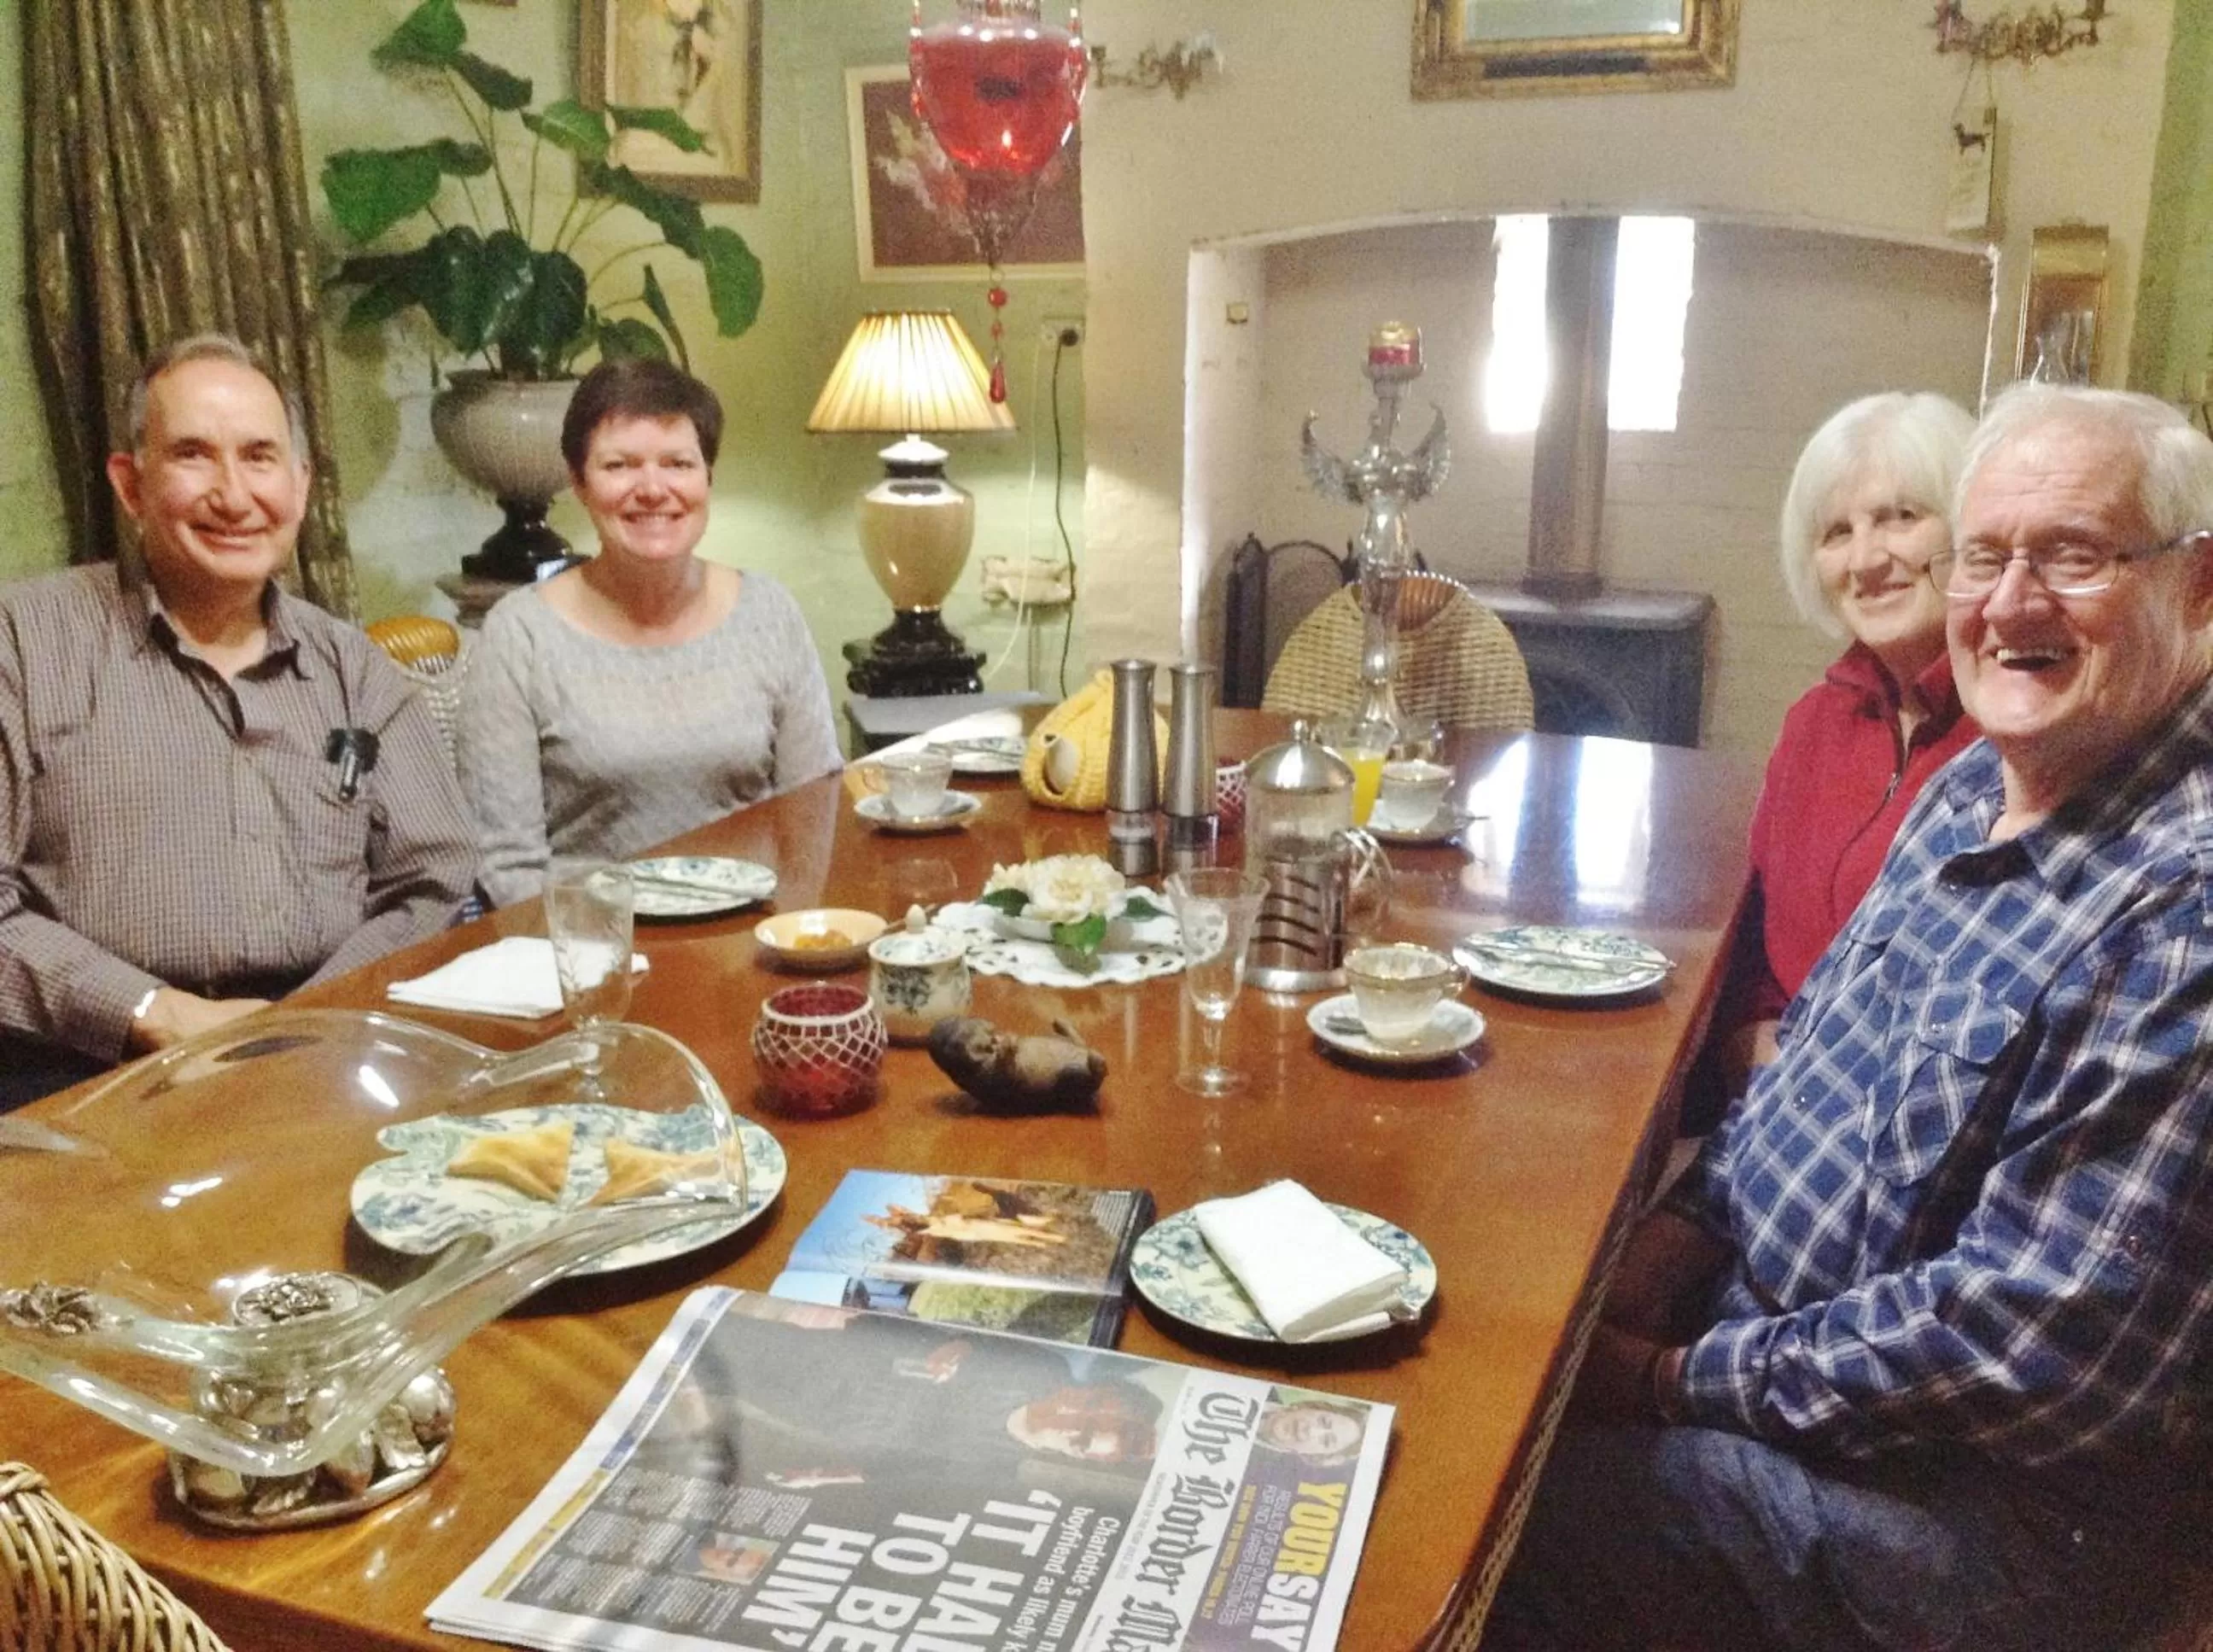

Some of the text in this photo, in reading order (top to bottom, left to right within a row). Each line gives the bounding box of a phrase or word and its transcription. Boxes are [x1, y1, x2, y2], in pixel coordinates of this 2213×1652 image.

[1182, 1392, 1259, 1466] The
[970, 1489, 1063, 1557] 'IT
[1042, 1506, 1095, 1575] boyfriend
[1065, 1516, 1121, 1597] Charlotte's
[1136, 1474, 1235, 1596] Border
[741, 1523, 877, 1648] HIM'
[808, 1512, 972, 1652] TO BE
[1033, 1575, 1055, 1595] as
[1251, 1482, 1347, 1652] YOUR SAY
[1007, 1596, 1049, 1638] likely
[1043, 1598, 1077, 1638] mum
